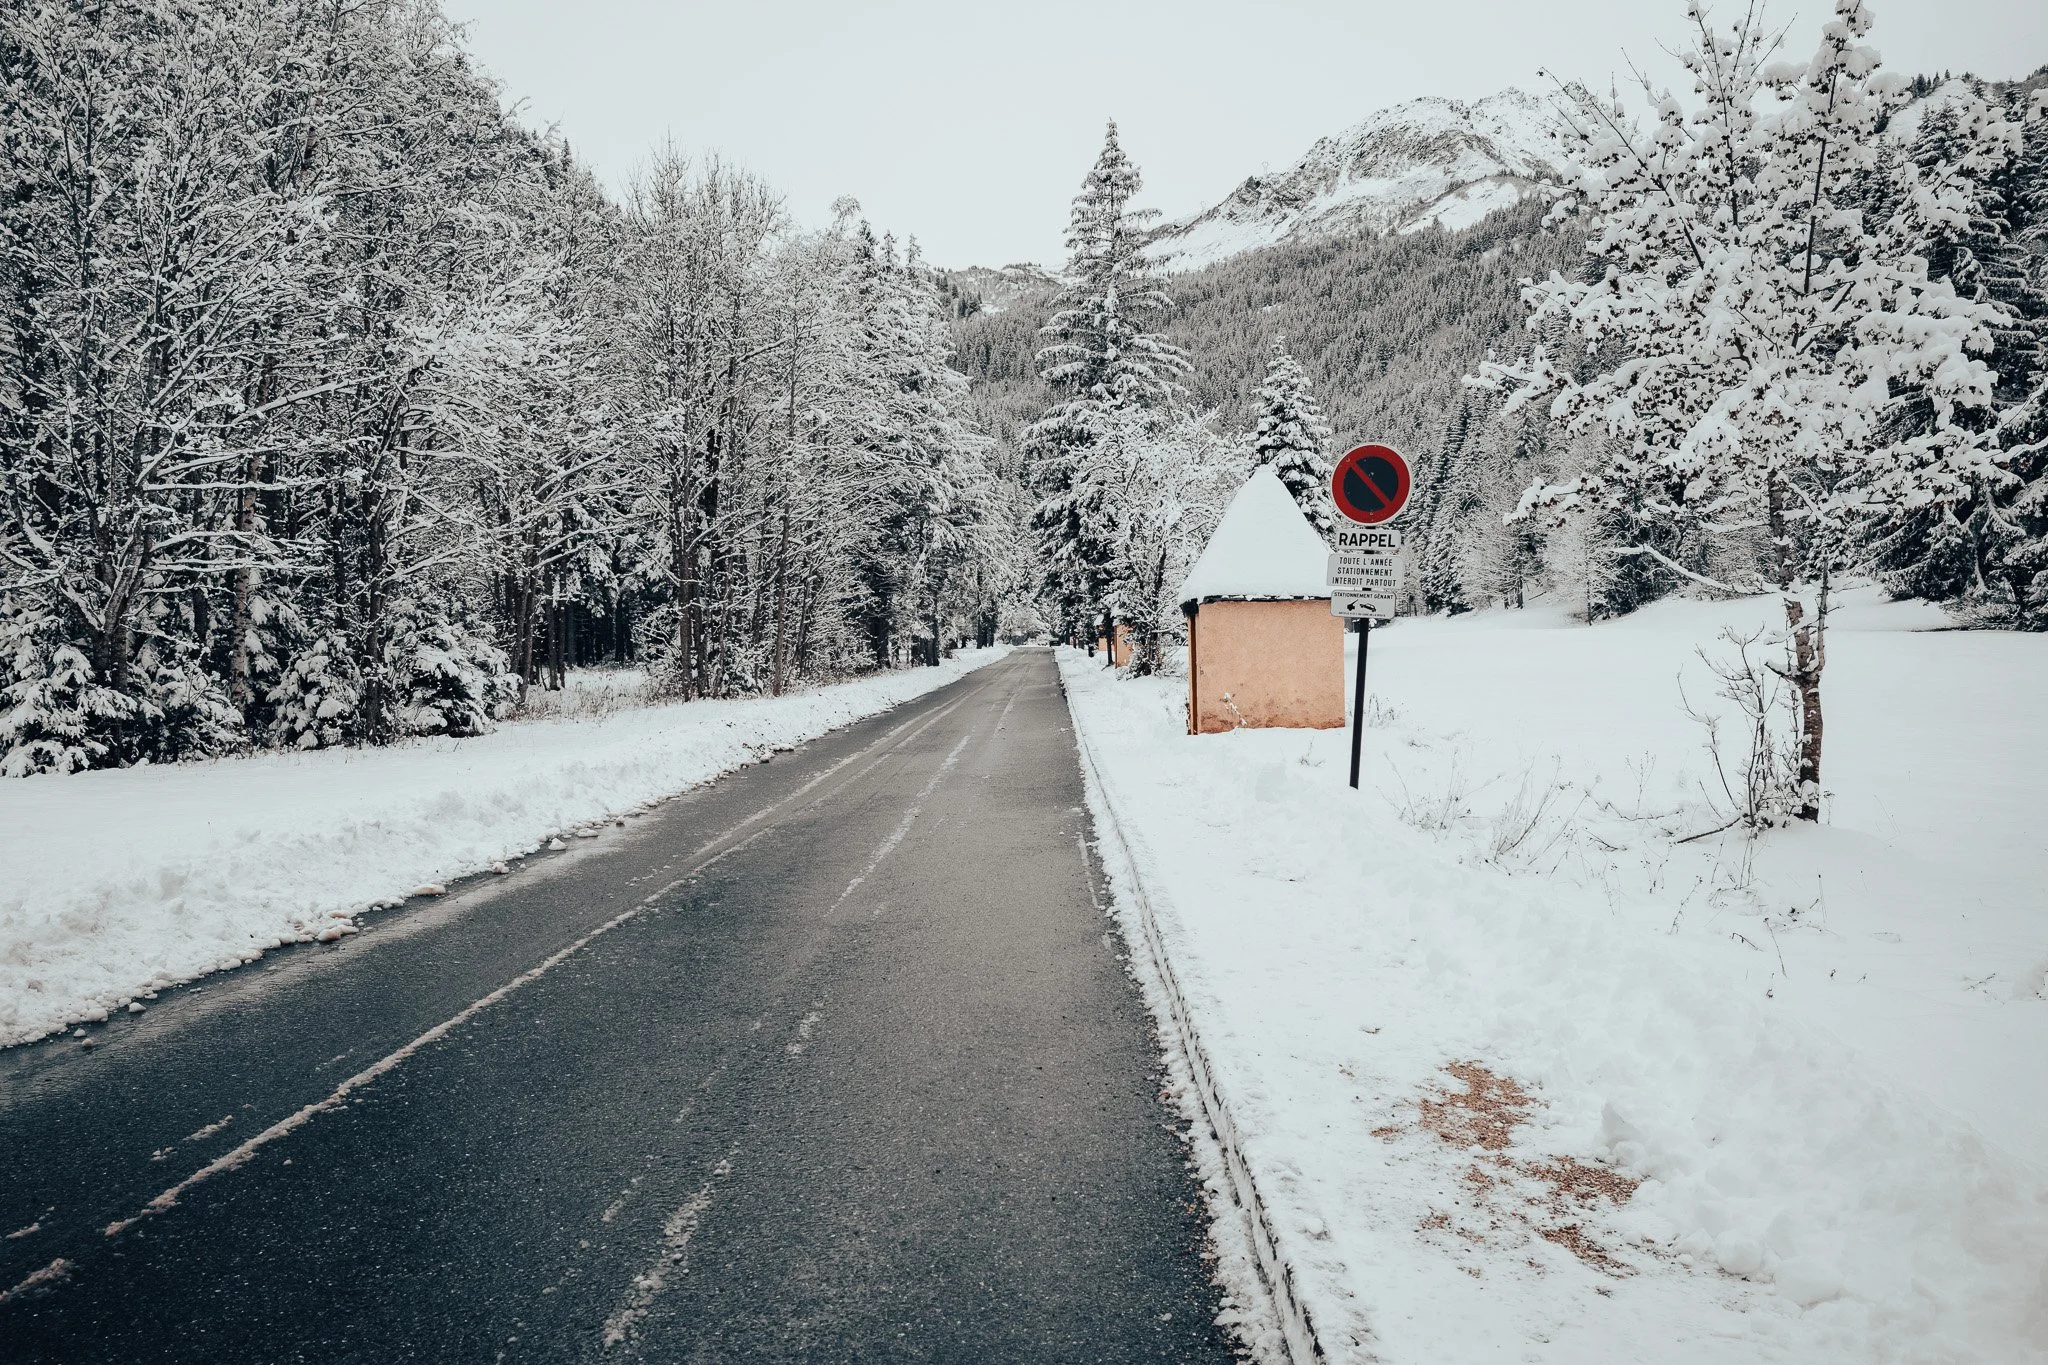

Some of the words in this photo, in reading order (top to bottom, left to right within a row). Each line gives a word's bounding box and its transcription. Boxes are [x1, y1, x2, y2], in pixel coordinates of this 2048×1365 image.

[1339, 533, 1396, 547] RAPPEL
[1364, 558, 1392, 566] L'ANNÉE
[1338, 567, 1392, 576] STATIONNEMENT
[1366, 578, 1396, 586] PARTOUT
